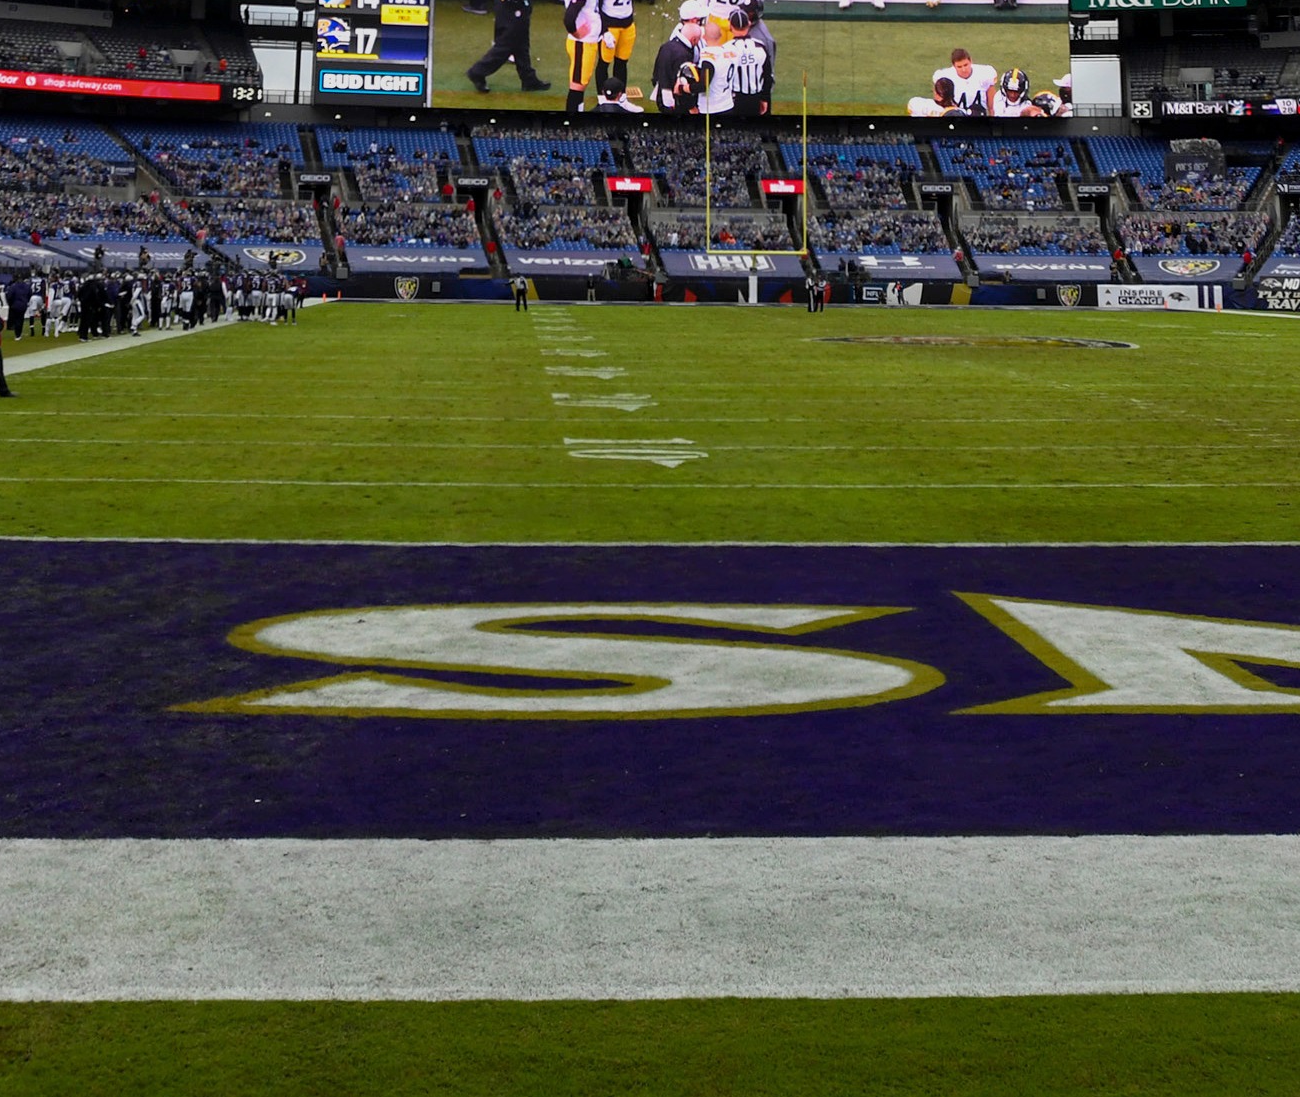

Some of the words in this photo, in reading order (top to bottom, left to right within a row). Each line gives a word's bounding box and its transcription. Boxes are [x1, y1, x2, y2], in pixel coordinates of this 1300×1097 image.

[355, 27, 378, 54] 17
[43, 76, 123, 92] shop.safeway.com
[322, 73, 364, 90] BUD
[363, 74, 420, 92] LIGHT
[1196, 100, 1225, 115] Bank
[299, 174, 331, 183] GEICO
[457, 178, 489, 187] GEICO
[921, 184, 952, 193] GEICO
[1078, 184, 1110, 193] GEICO
[1119, 288, 1163, 297] INSPIRE
[1117, 296, 1165, 306] CHANGE
